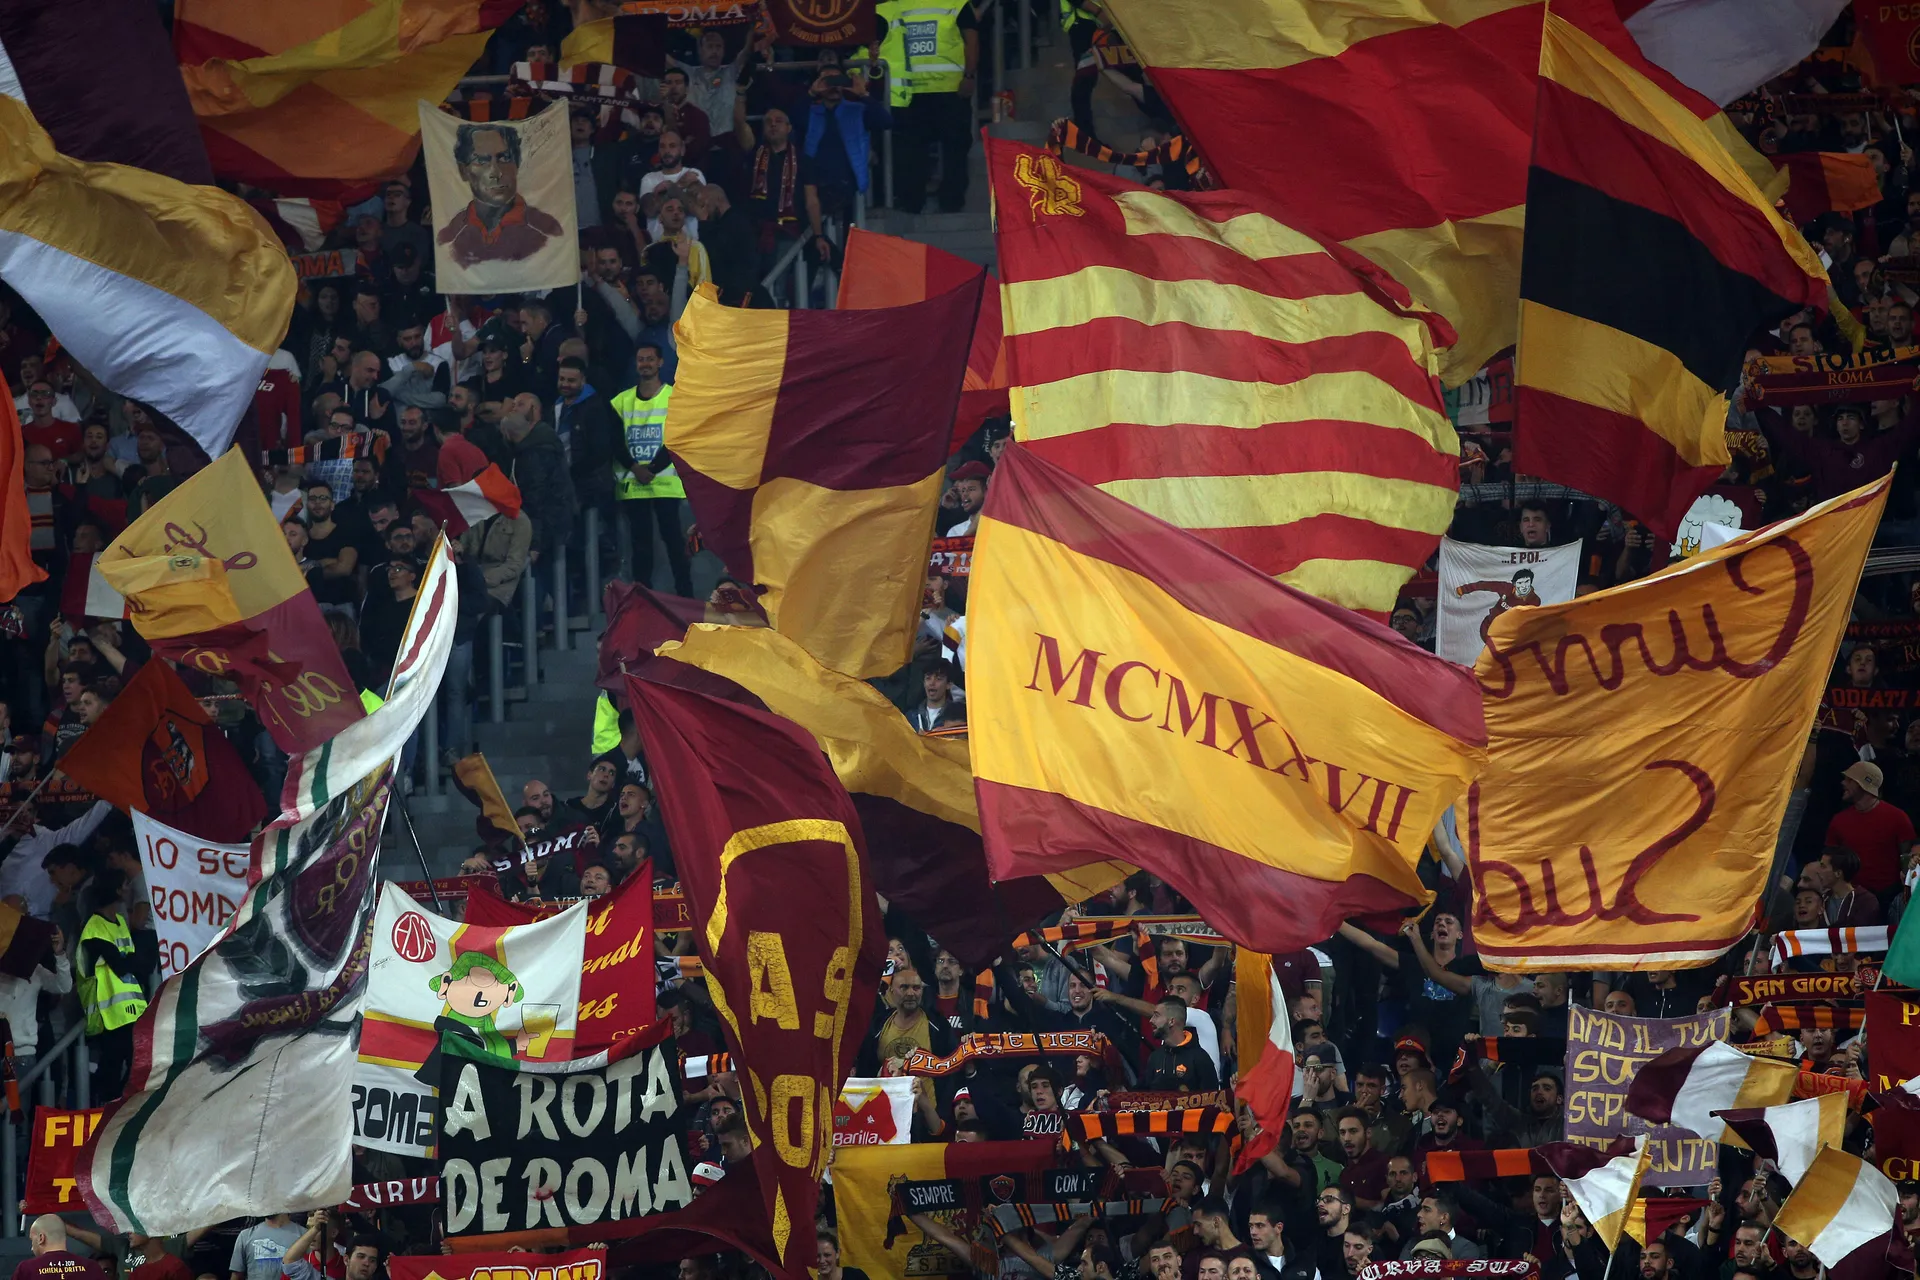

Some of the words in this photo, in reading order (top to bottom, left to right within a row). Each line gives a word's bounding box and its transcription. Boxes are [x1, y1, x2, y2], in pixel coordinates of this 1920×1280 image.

[1828, 371, 1875, 385] ROMA
[628, 427, 661, 440] STEWARD
[1831, 688, 1909, 708] ODIATI
[1026, 633, 1417, 843] MCMXXVII
[146, 834, 179, 869] IO
[1739, 979, 1785, 1005] SAN
[1569, 1009, 1626, 1051] AMA
[1631, 1024, 1664, 1054] IL
[1671, 1012, 1731, 1048] TUO
[444, 1063, 492, 1142] A
[512, 1044, 679, 1142] ROTA
[1177, 1090, 1227, 1109] ROMA
[832, 1129, 879, 1147] Barilla
[441, 1156, 512, 1234] DE
[521, 1133, 694, 1231] ROMA
[1055, 1174, 1079, 1193] CON
[909, 1184, 955, 1206] SEMPRE
[64, 1265, 86, 1273] DRITTA
[1466, 1260, 1530, 1274] SUD
